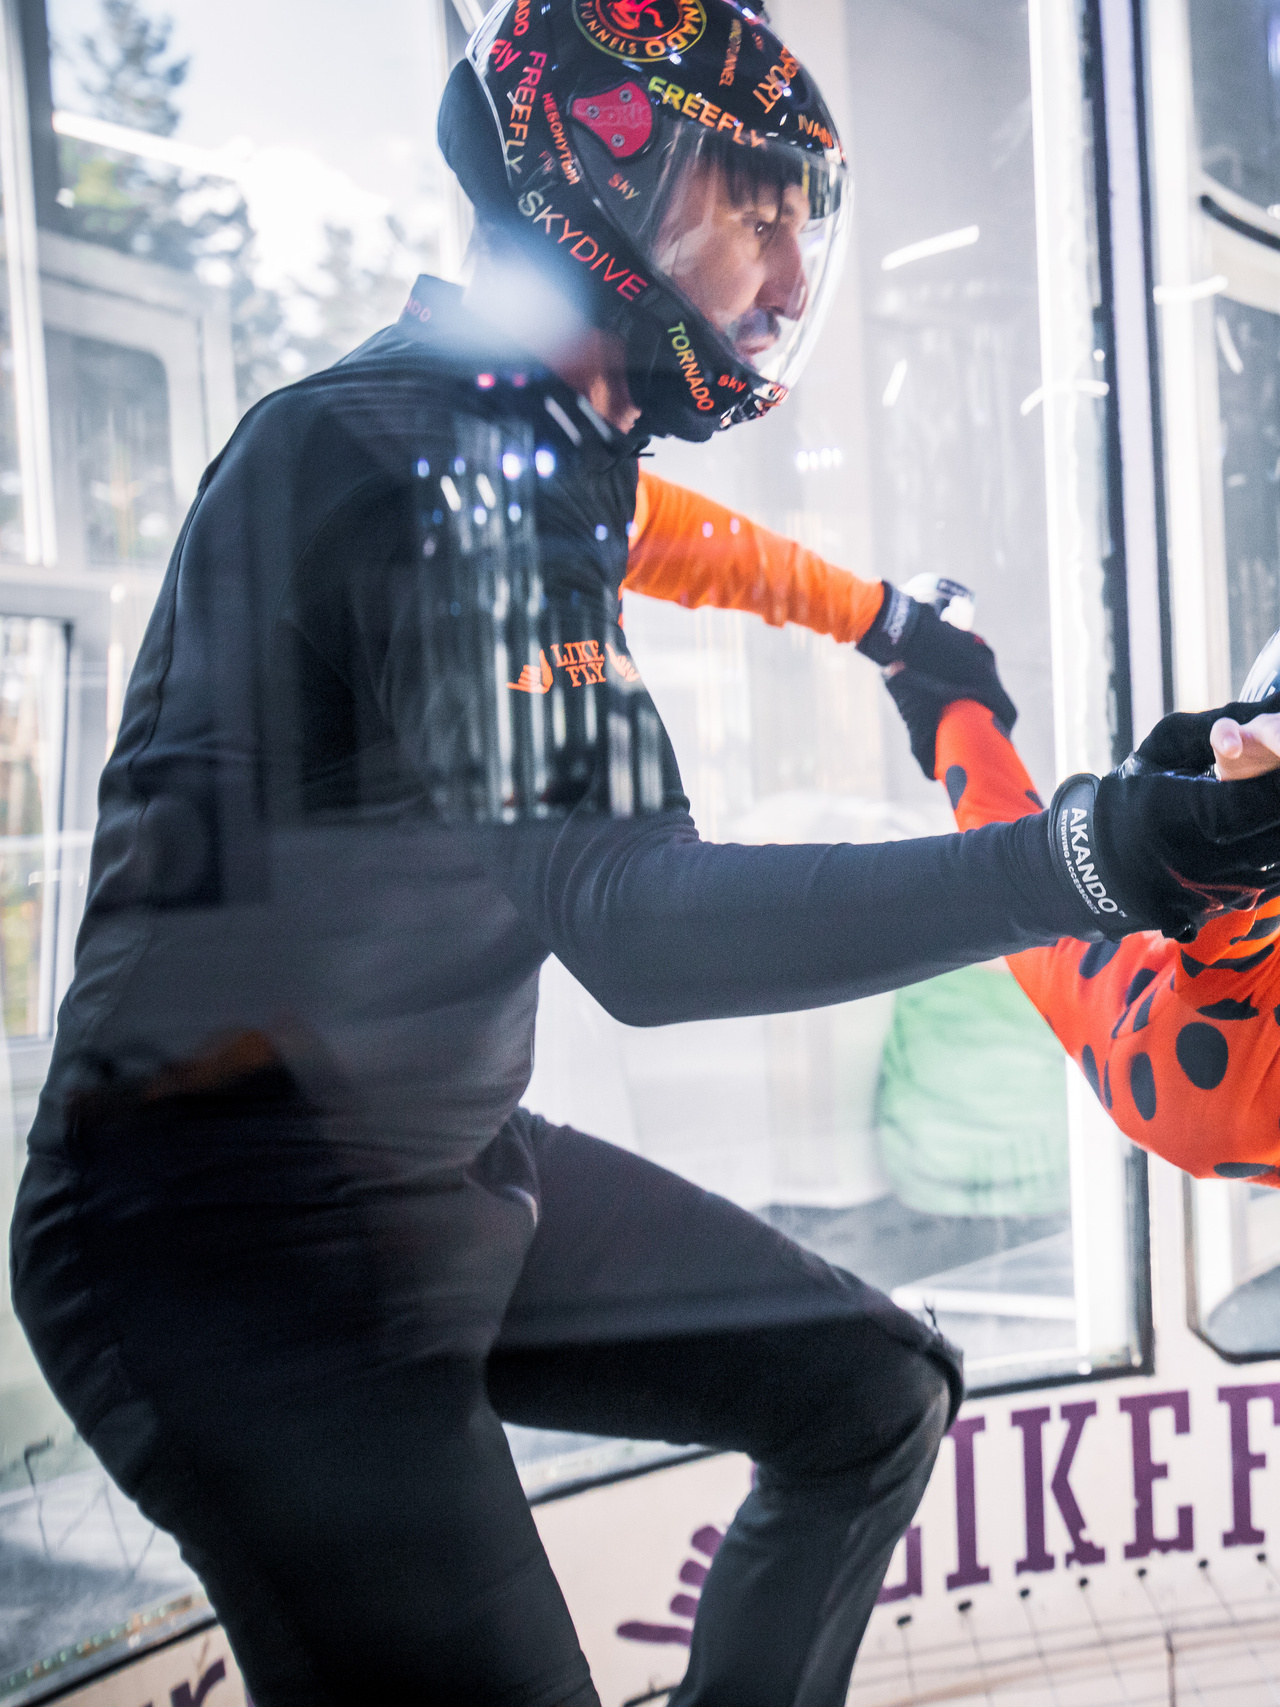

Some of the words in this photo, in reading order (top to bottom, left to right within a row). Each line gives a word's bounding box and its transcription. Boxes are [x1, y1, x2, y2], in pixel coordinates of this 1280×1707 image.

[505, 51, 548, 174] FREEFLY
[648, 76, 766, 151] FREEFLY
[518, 190, 648, 301] SKYDIVE
[667, 321, 714, 411] TORNADO
[550, 640, 605, 667] LIKE
[565, 662, 606, 687] FLY
[1060, 809, 1070, 858] SKYDIVING
[1070, 807, 1118, 913] AKANDO
